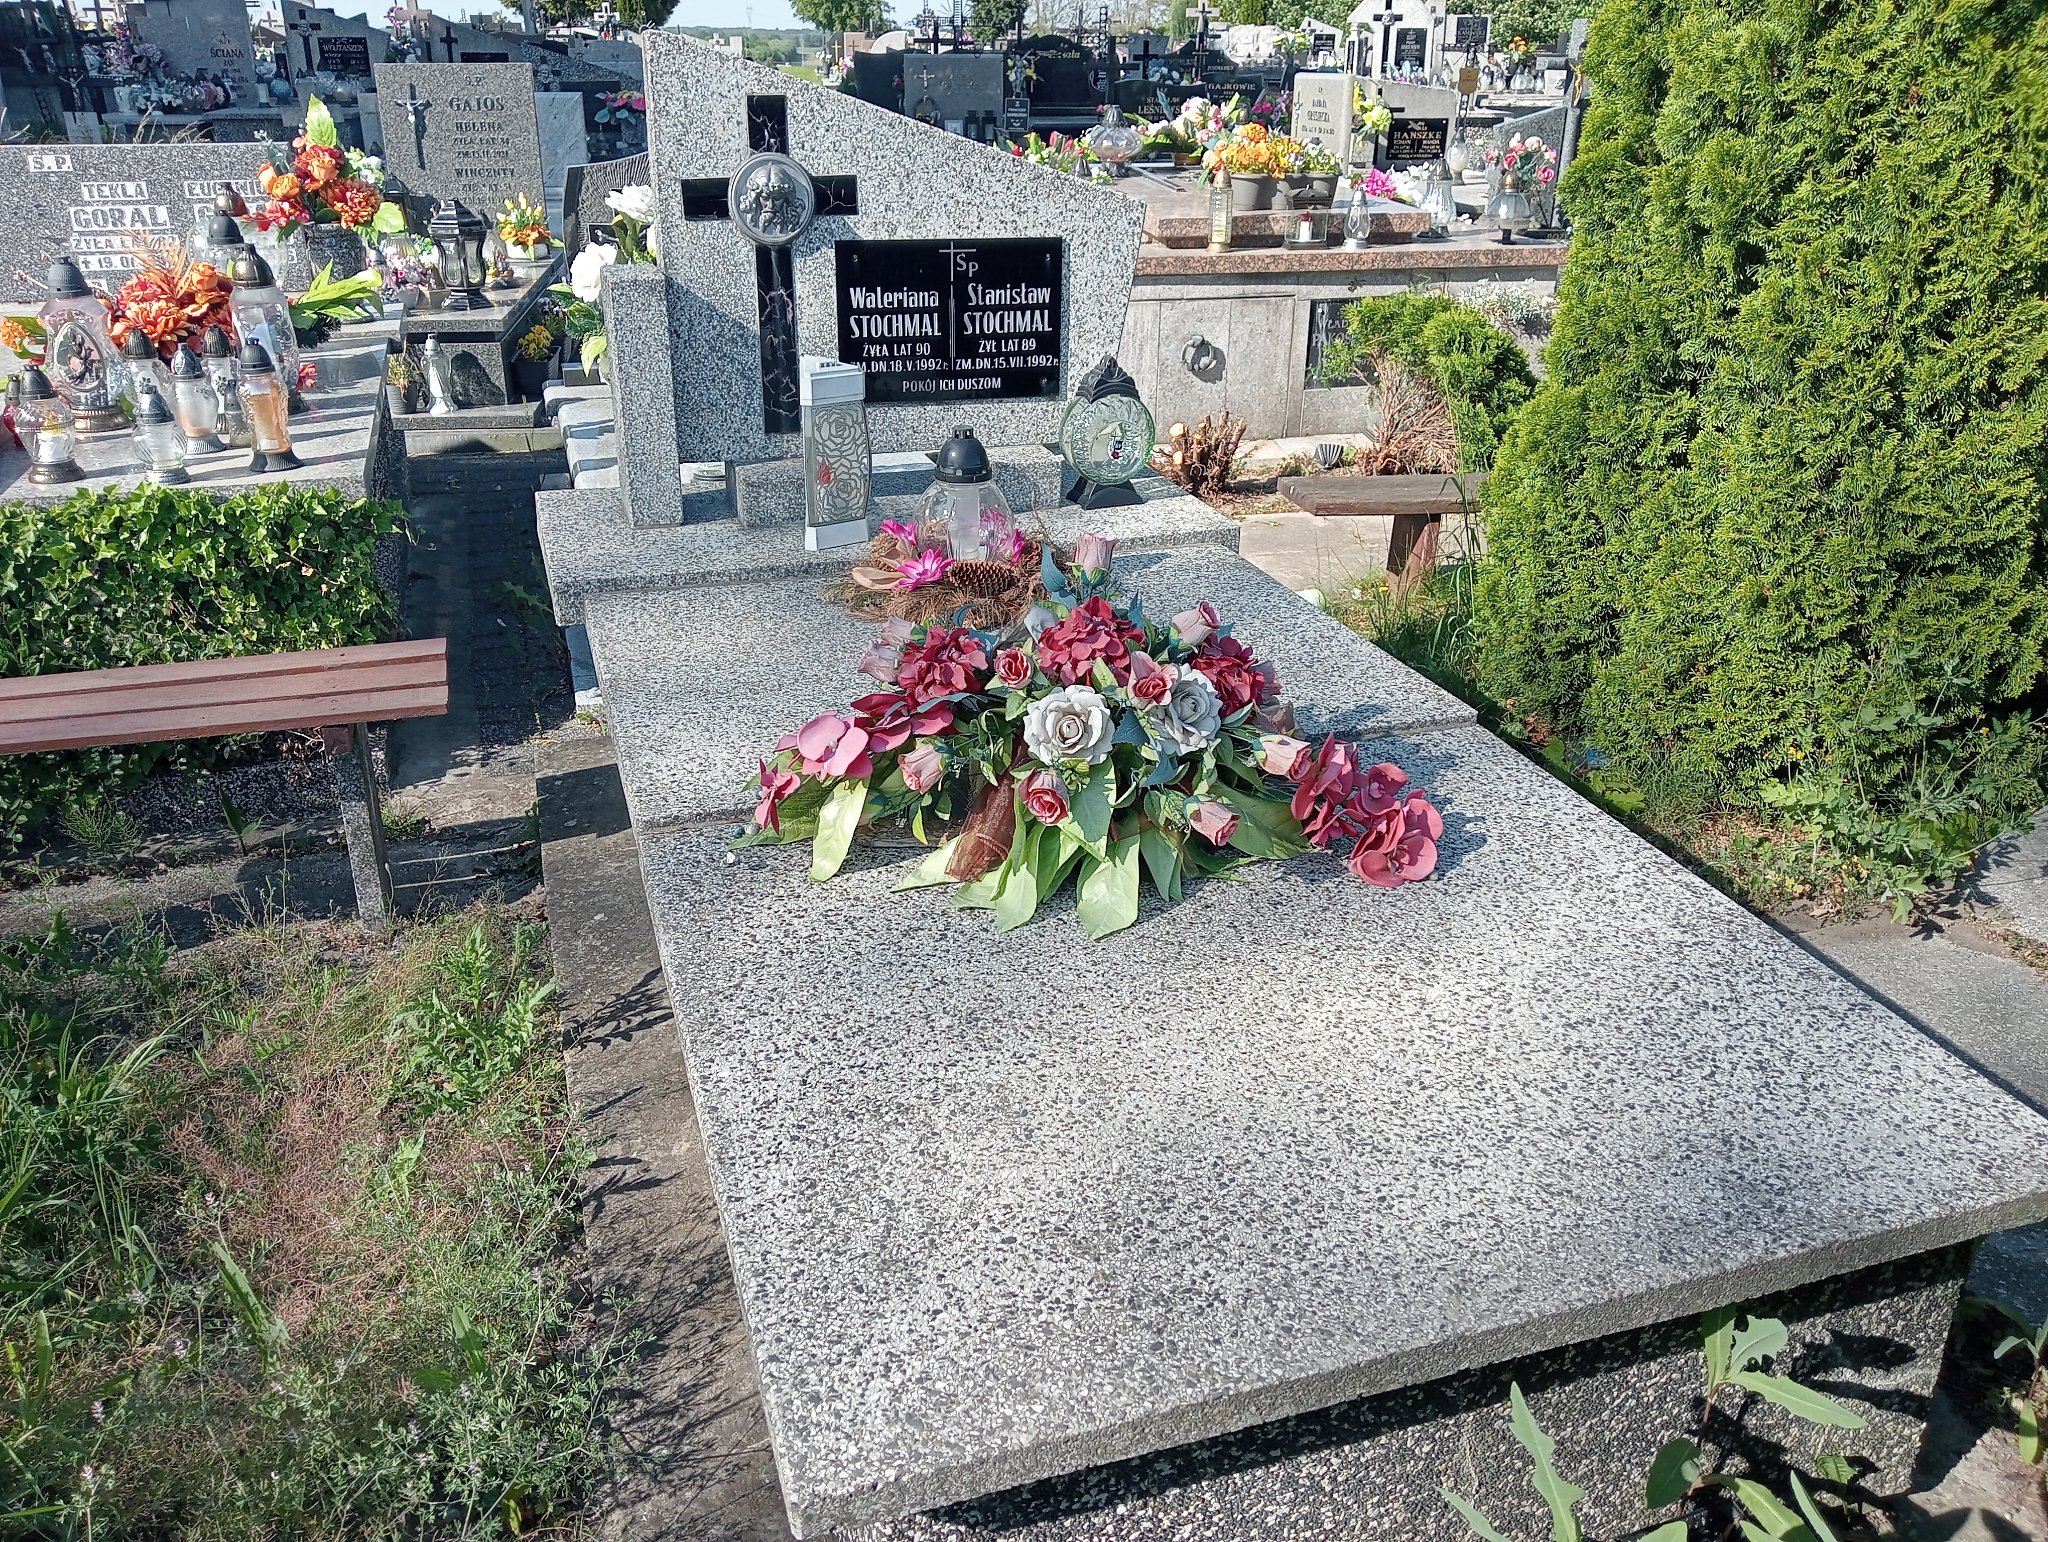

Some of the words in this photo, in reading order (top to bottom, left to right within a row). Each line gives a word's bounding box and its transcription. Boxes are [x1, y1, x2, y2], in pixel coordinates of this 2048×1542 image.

[455, 121, 502, 132] HELENA
[83, 183, 146, 199] TEKLA
[850, 287, 939, 309] Waleriana
[967, 283, 1051, 306] Stanisław
[850, 313, 942, 339] STOCHMAL
[963, 309, 1052, 335] STOCHMAL
[863, 342, 889, 357] ŻYŁA
[894, 343, 912, 356] LAT
[916, 342, 931, 356] 90
[979, 338, 997, 353] ŻYŁ
[1001, 339, 1019, 352] LAT
[1021, 338, 1036, 351] 89
[903, 378, 936, 393] POKÓJ
[939, 379, 955, 391] ICH
[957, 377, 1001, 390] DUSZOM
